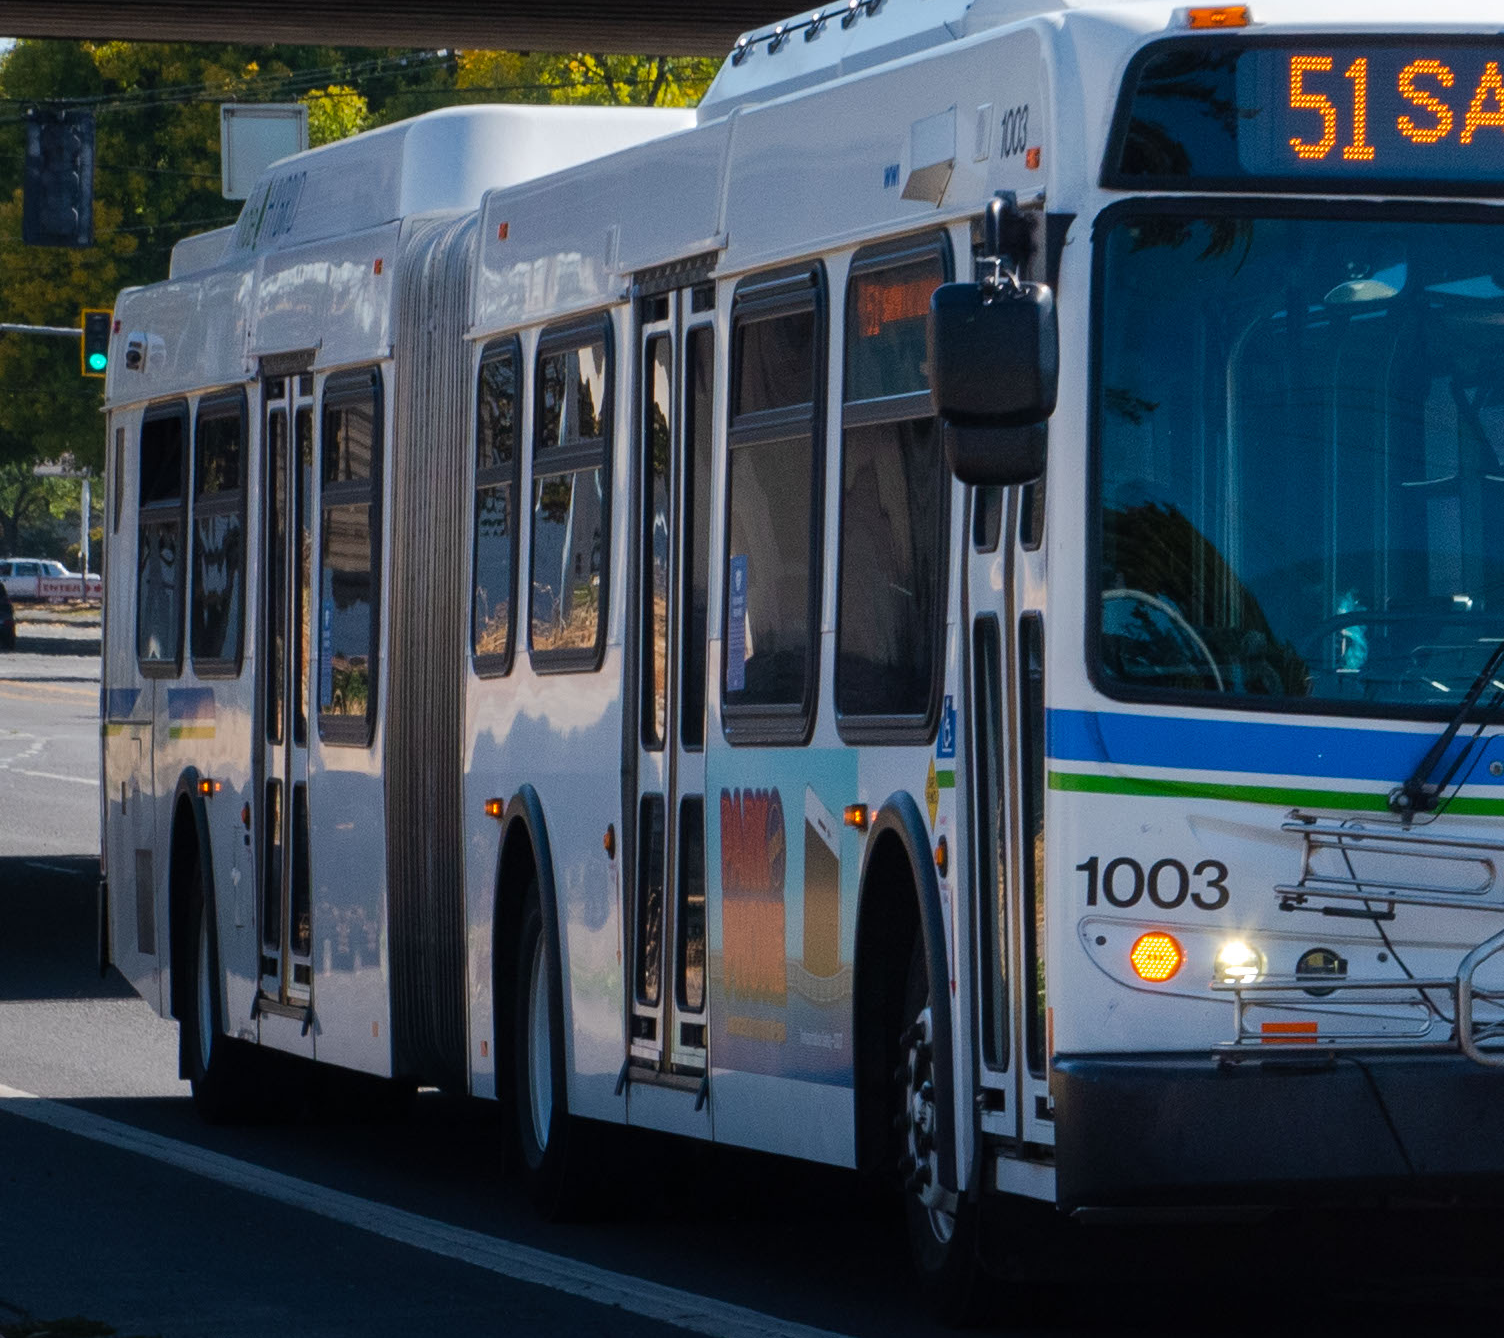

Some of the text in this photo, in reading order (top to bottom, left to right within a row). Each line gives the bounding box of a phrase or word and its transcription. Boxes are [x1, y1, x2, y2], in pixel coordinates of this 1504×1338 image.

[1001, 103, 1029, 159] 1003
[1290, 56, 1375, 159] 51
[1075, 856, 1230, 911] 1003
